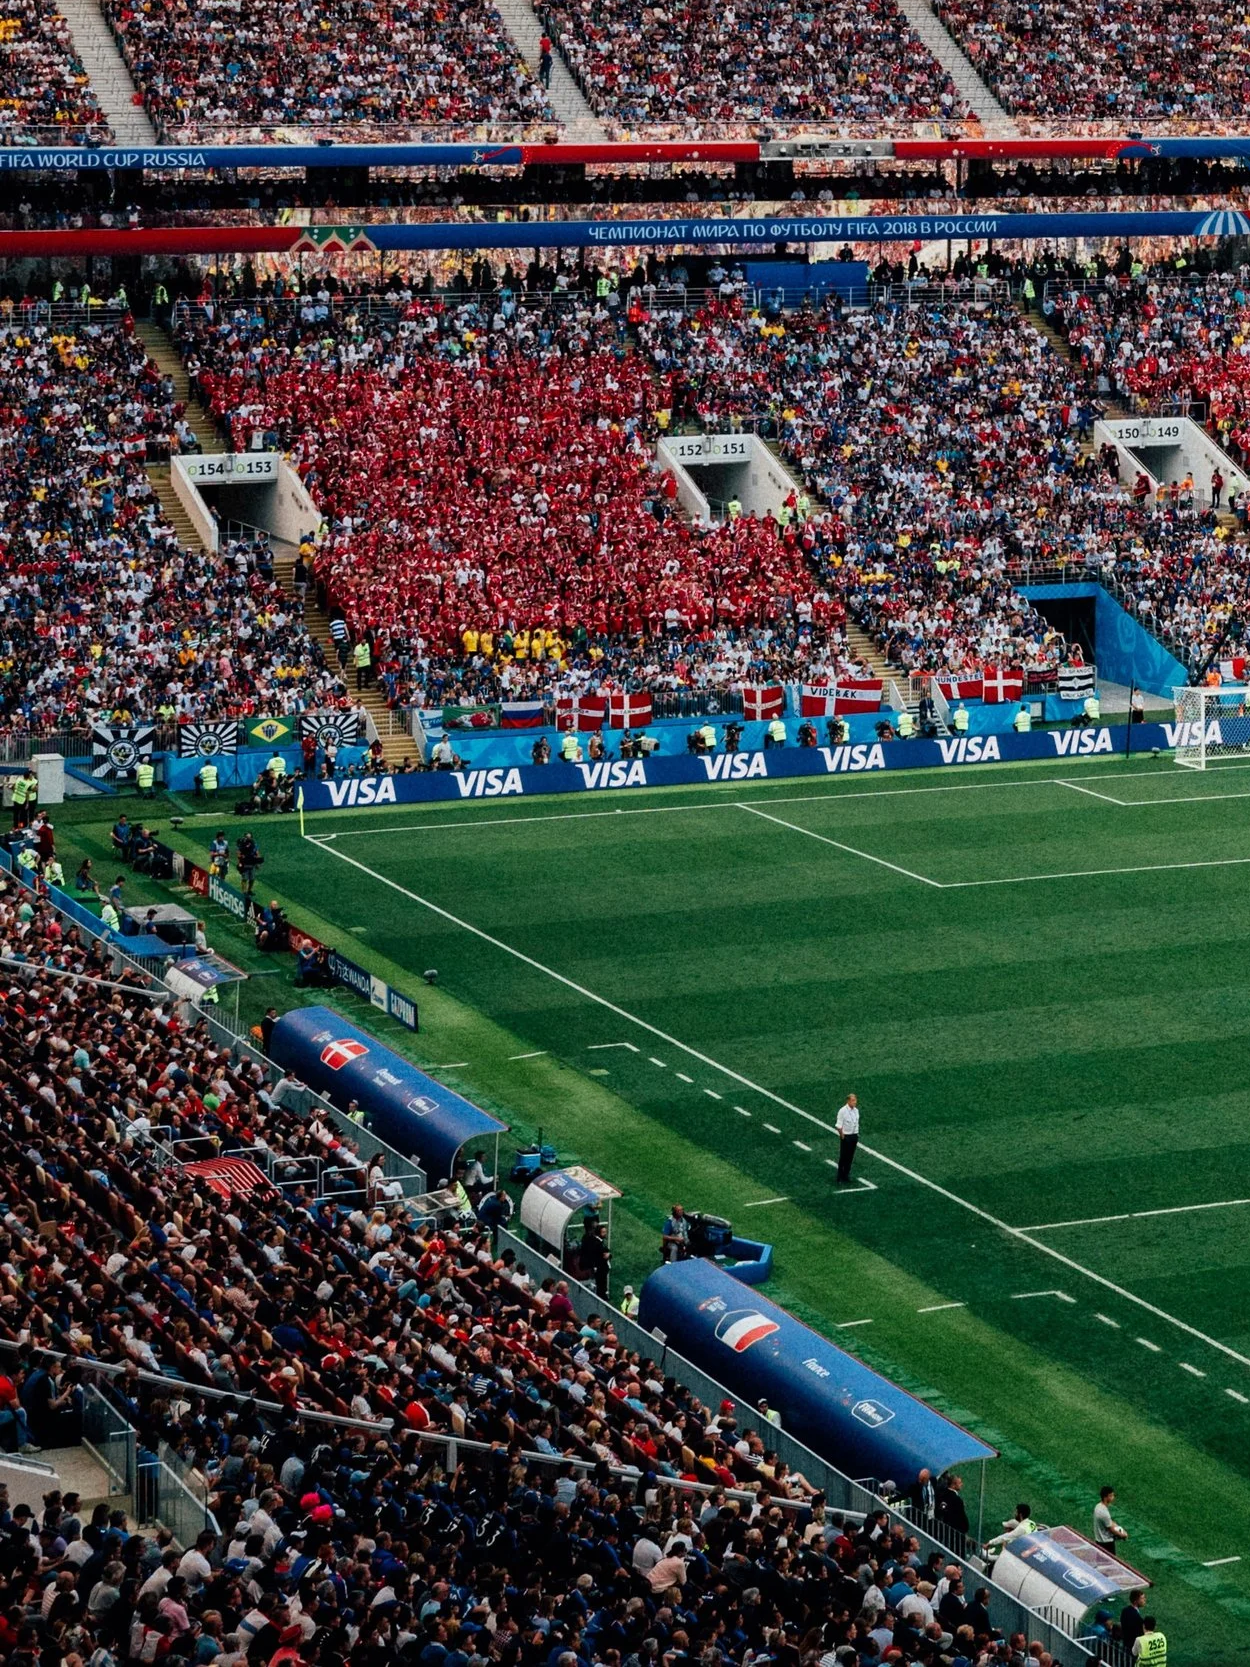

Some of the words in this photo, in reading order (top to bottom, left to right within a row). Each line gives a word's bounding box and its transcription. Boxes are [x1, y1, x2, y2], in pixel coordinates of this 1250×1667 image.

[0, 154, 34, 168] FIFA
[38, 154, 100, 168] WORLD
[103, 153, 139, 167] CUP
[143, 153, 206, 167] RUSSIA
[589, 226, 688, 239] ЧЕМПИОНАТ
[692, 225, 739, 238] МИРА
[744, 224, 765, 237] ПО
[770, 222, 843, 237] ФУТБОЛУ
[848, 222, 879, 235] FIFA
[883, 221, 917, 234] 2018
[921, 221, 931, 234] В
[935, 220, 997, 233] РОССИИ
[1117, 428, 1139, 439] 150
[1157, 426, 1179, 437] 149
[679, 444, 702, 456] 152
[723, 443, 746, 454] 151
[198, 464, 225, 475] 154
[246, 461, 272, 473] 153
[810, 687, 857, 699] VIDEBÆK
[1048, 728, 1113, 756] VISA
[1159, 720, 1223, 748] VISA
[817, 743, 886, 772] VISA
[934, 735, 1001, 764] VISA
[575, 760, 647, 789] VISA
[698, 751, 768, 780] VISA
[322, 775, 396, 806] VISA
[450, 767, 524, 798] VISA
[209, 877, 246, 919] Hisense
[348, 969, 371, 995] WANDA
[802, 1358, 831, 1379] France
[1148, 1639, 1165, 1651] 2525
